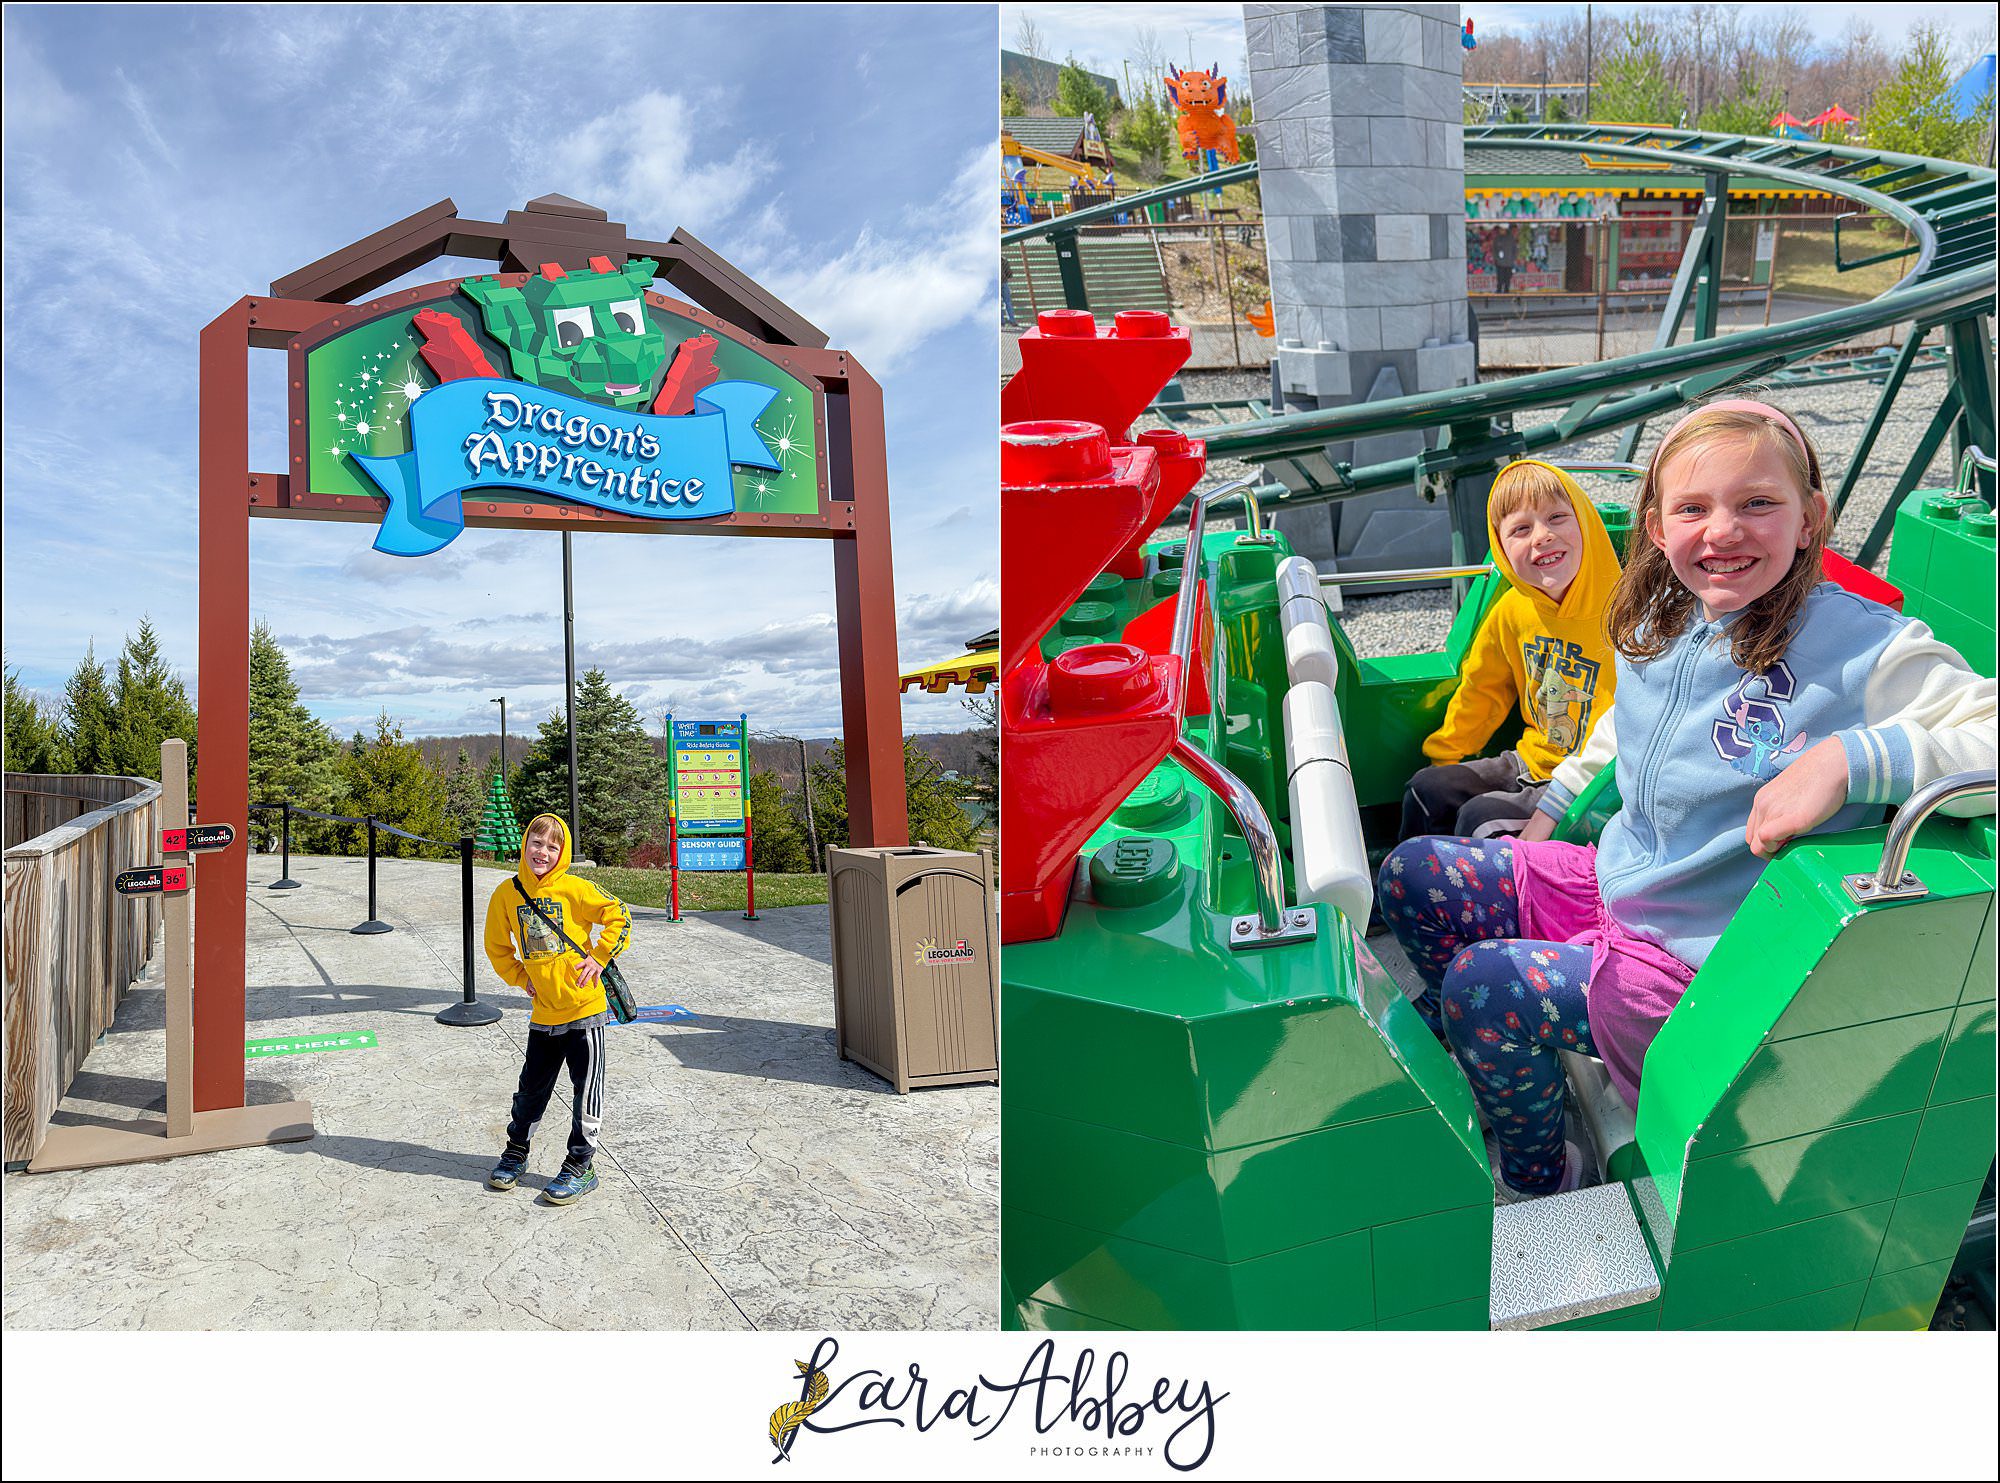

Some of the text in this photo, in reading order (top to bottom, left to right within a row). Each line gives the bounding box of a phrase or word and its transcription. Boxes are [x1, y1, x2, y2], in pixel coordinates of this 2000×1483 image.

[486, 390, 660, 459] Dragon's
[466, 430, 705, 505] Apprentice
[1526, 635, 1590, 662] STAR
[1526, 650, 1588, 679] WARS
[197, 830, 231, 843] LEGOLAND
[681, 841, 716, 849] SENSORY
[127, 875, 161, 888] LEGOLAND
[928, 941, 974, 958] LEGOLAND
[245, 1038, 352, 1053] TER HERE
